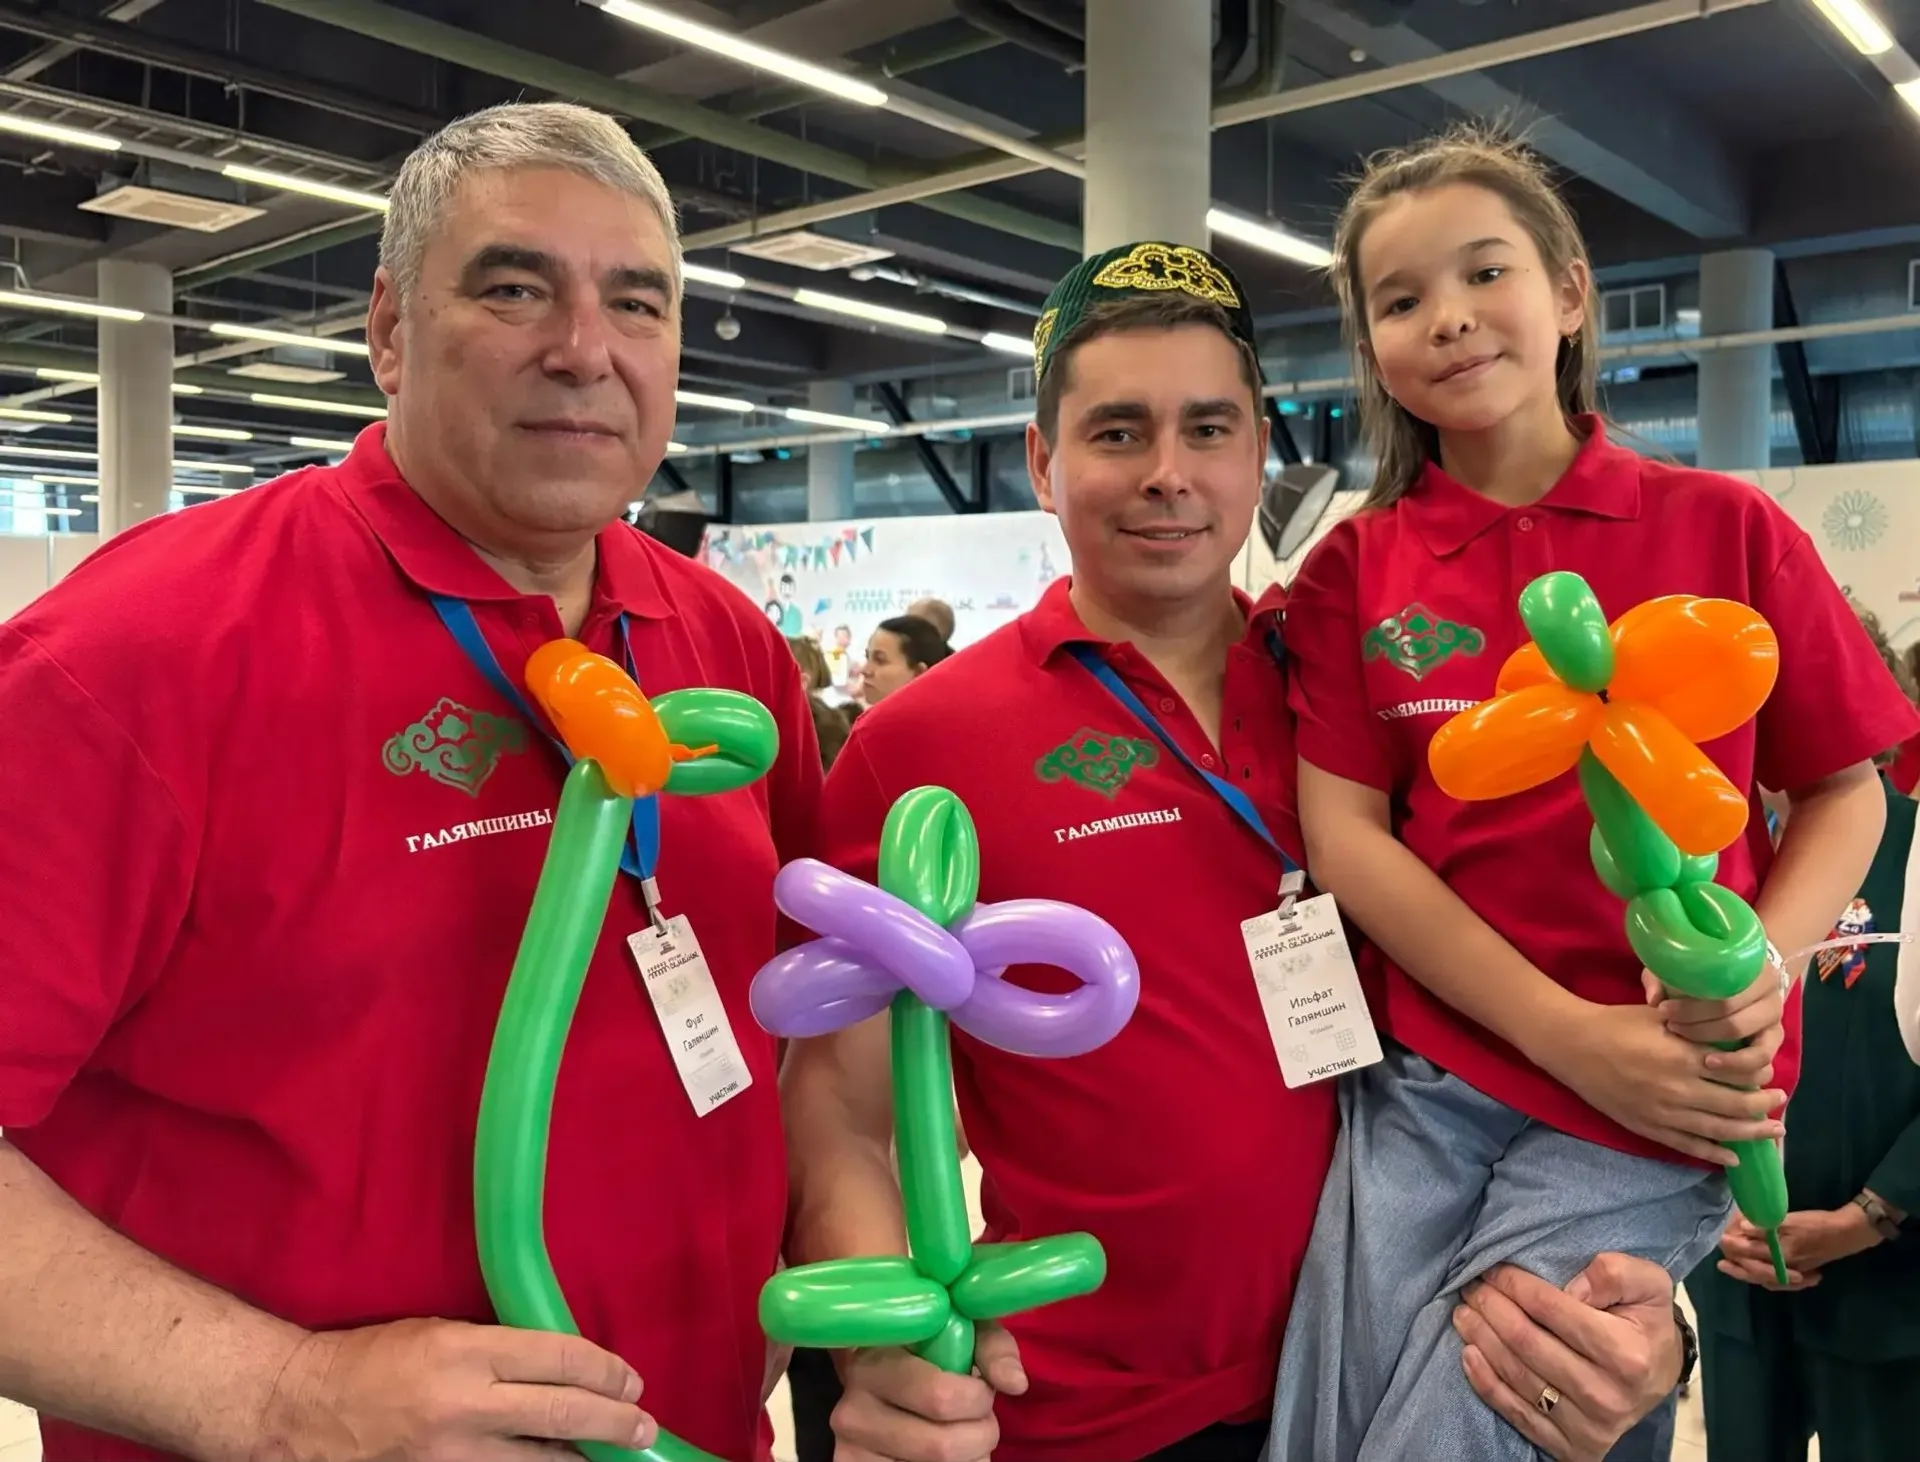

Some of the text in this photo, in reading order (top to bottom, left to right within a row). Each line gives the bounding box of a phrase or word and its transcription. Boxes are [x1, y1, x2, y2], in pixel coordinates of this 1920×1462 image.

[1377, 698, 1481, 721] ГАЛЯМШИН
[405, 808, 553, 853] ГАЛЯМШИНЫ
[1054, 807, 1183, 843] ГАЛЯМШИНЫ
[1290, 988, 1333, 1009] Ильфат
[685, 1013, 705, 1029] Фуат
[1288, 1002, 1346, 1028] Галямшин
[1307, 1056, 1358, 1078] УЧАСТНИК
[708, 1081, 739, 1105] УЧАСТНИК
